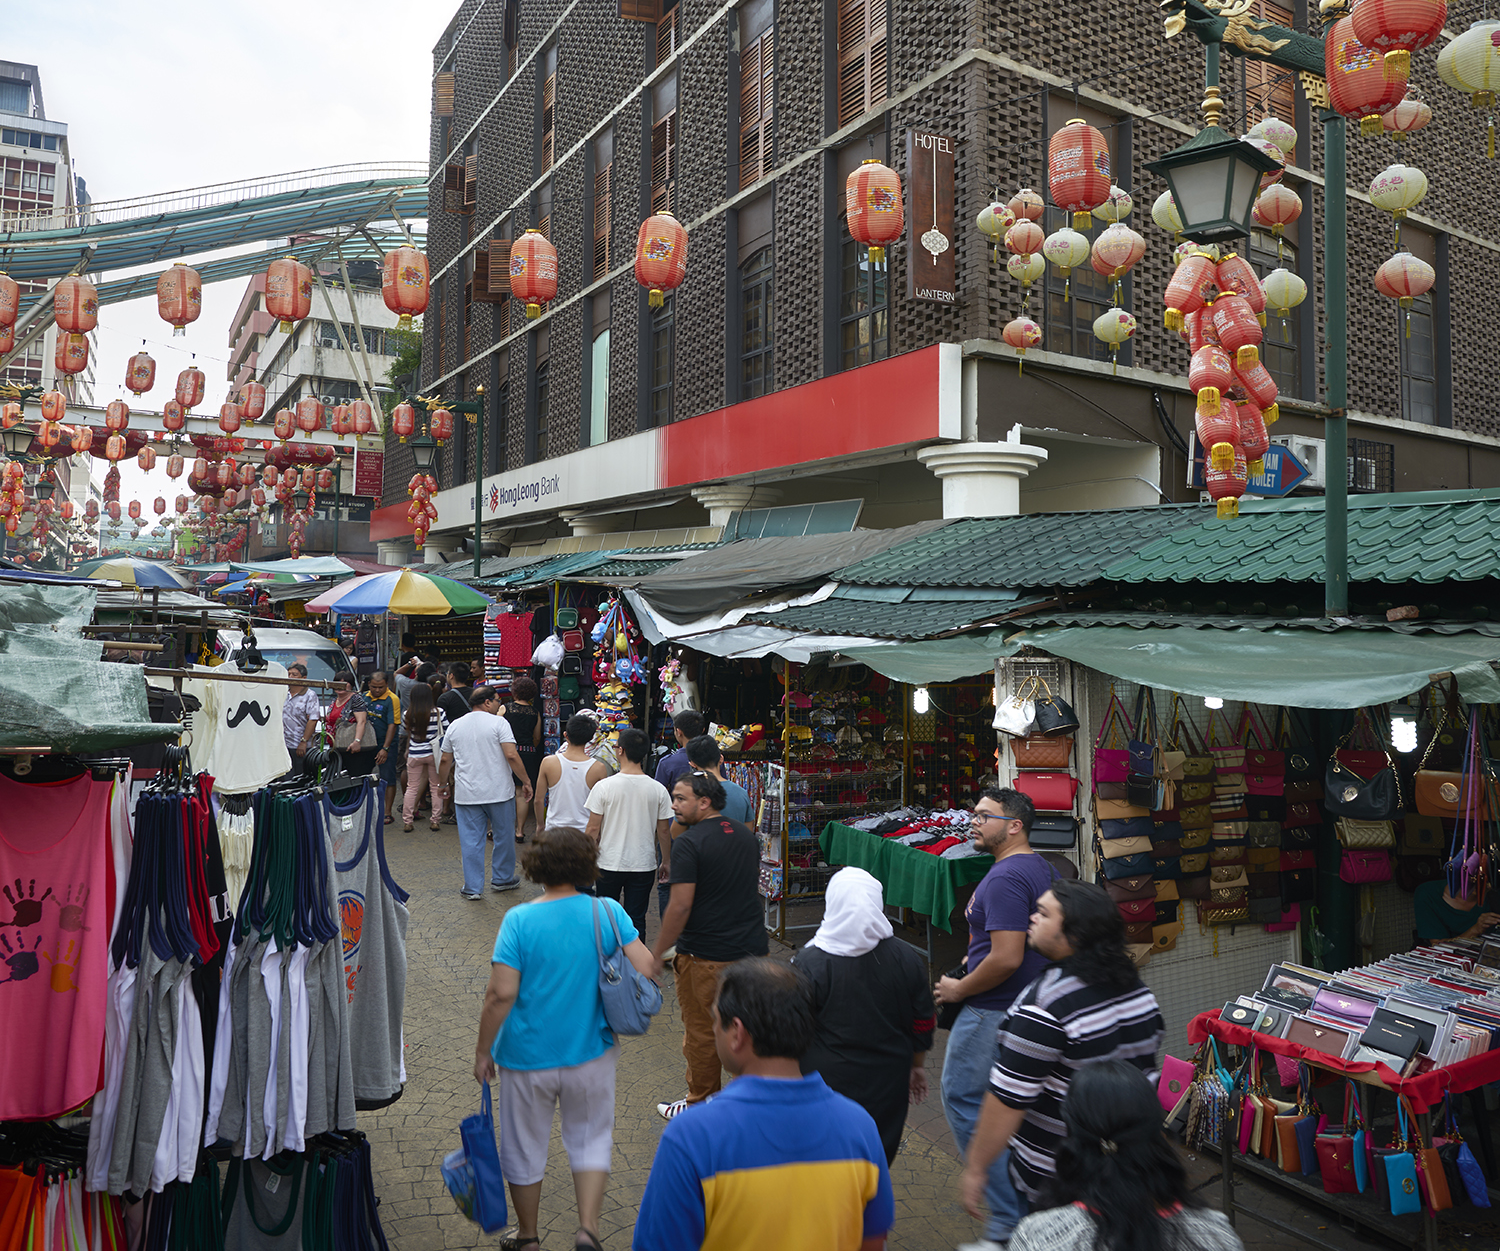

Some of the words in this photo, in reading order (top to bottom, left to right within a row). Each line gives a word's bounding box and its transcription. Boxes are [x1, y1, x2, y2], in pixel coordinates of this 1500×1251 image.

[915, 133, 952, 154] HOTEL
[915, 287, 955, 301] LANTERN
[541, 474, 560, 496] Bank
[1251, 472, 1276, 488] TOILET
